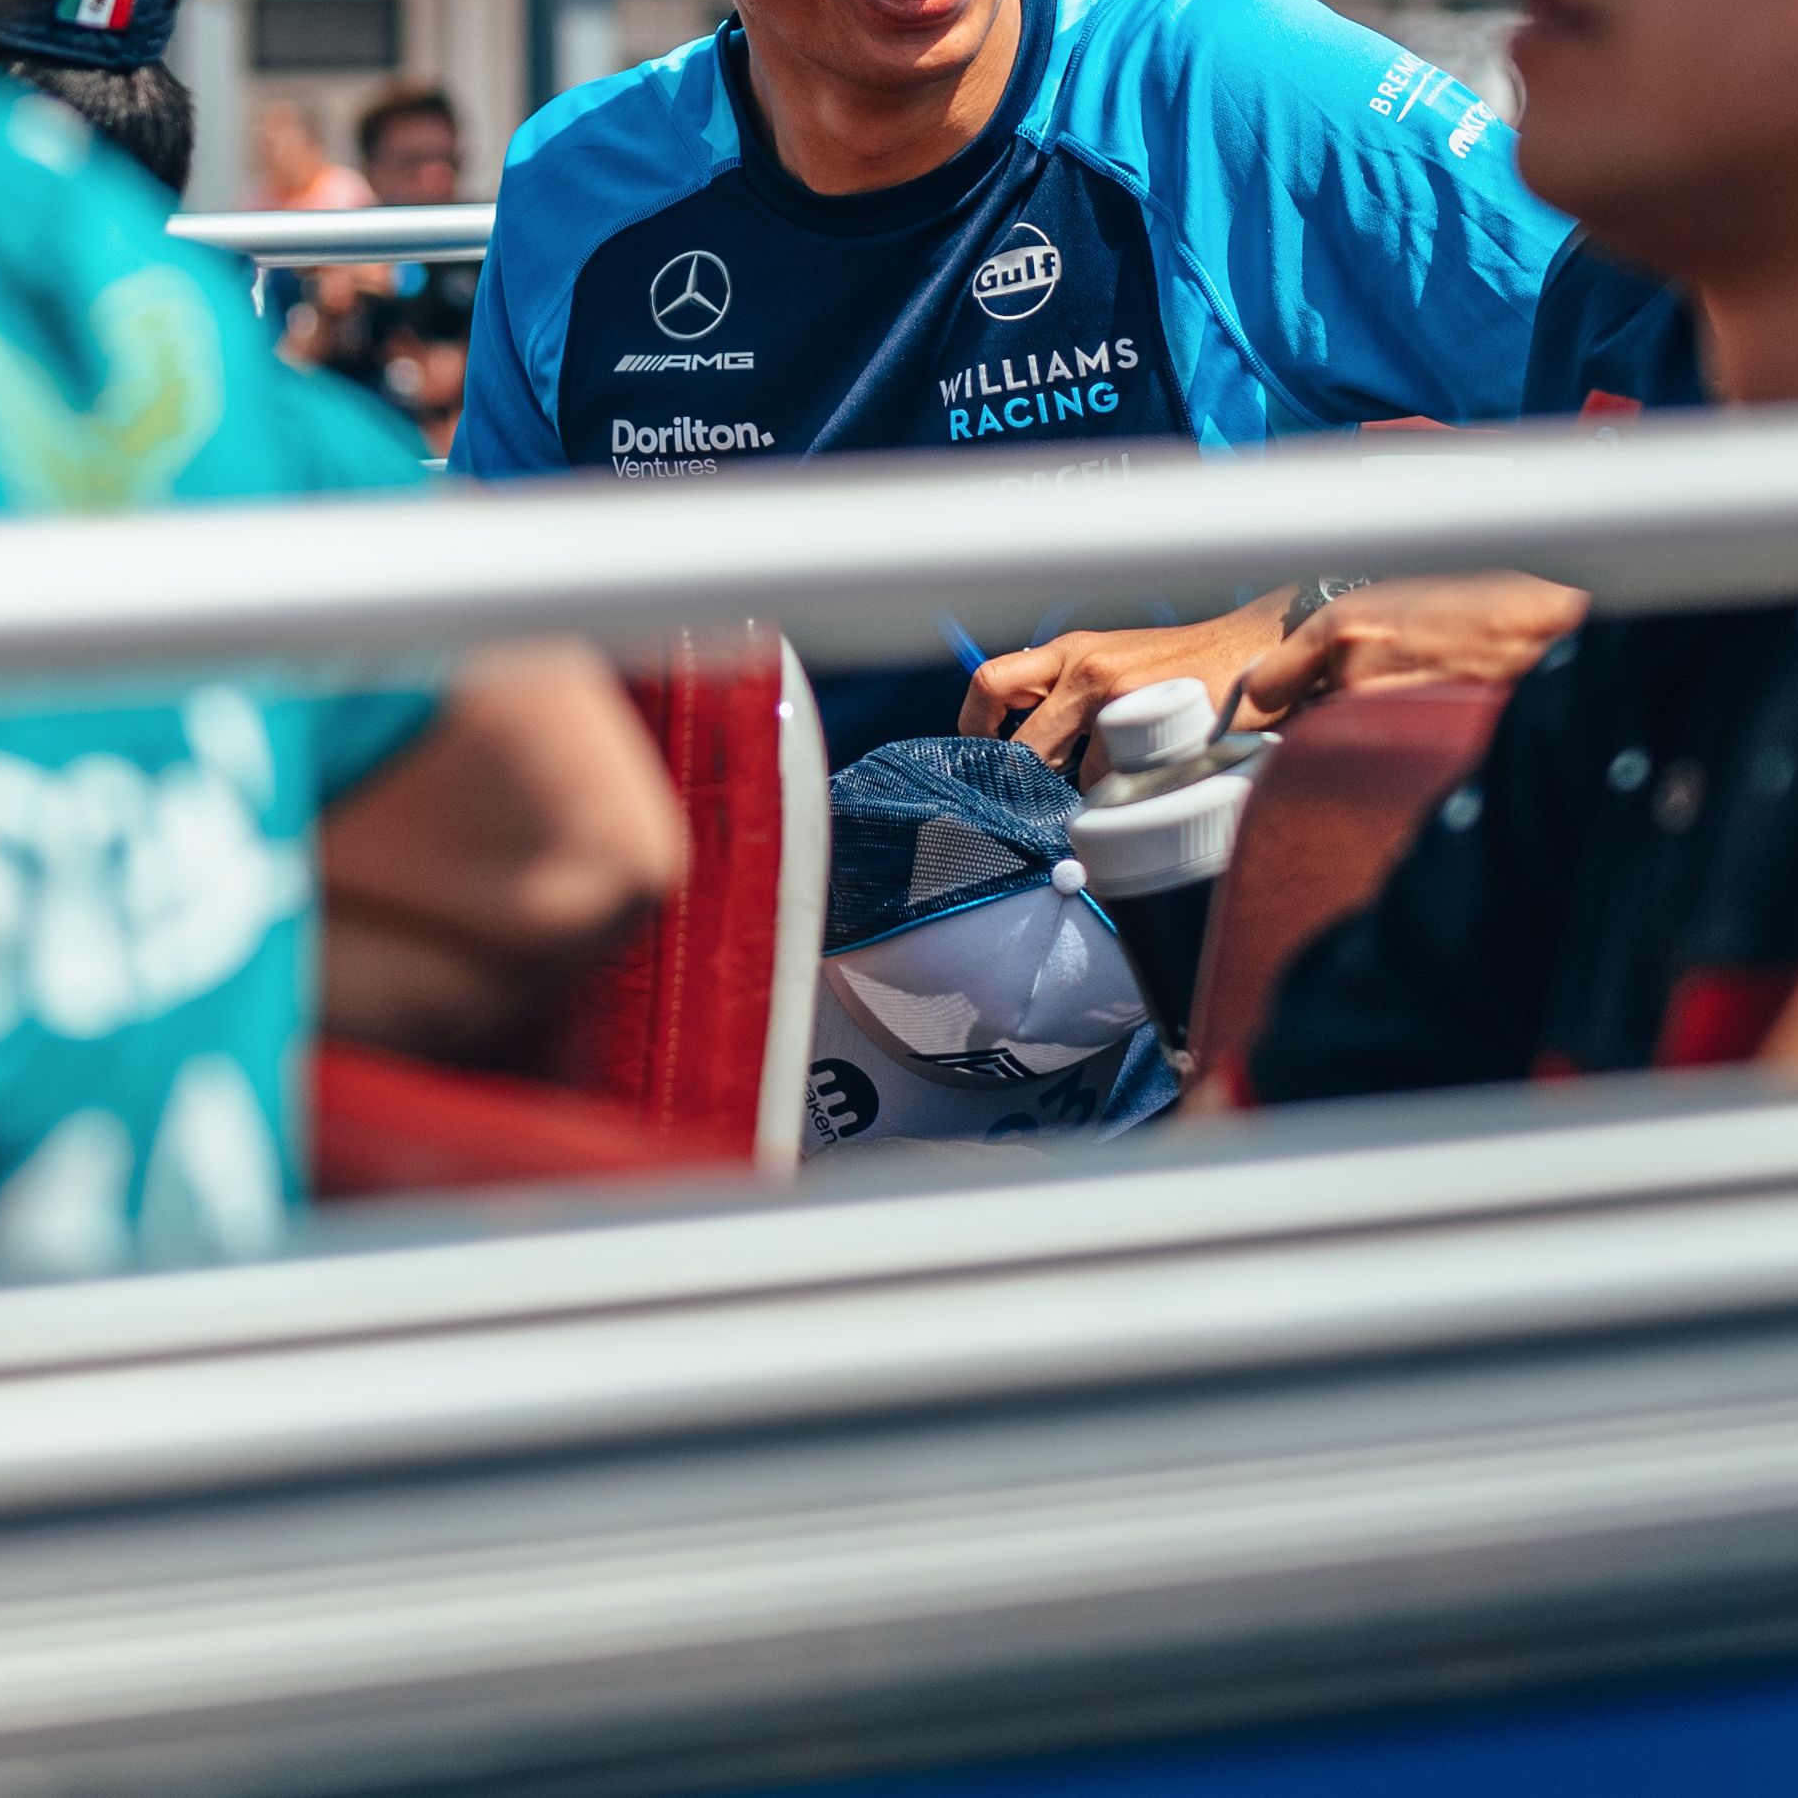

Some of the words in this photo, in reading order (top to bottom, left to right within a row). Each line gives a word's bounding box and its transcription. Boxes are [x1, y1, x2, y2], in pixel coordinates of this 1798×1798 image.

[975, 252, 1057, 293] Gulf
[657, 352, 755, 372] AMG
[939, 338, 1139, 408] WILLIAMS
[949, 381, 1119, 441] RACING
[612, 455, 718, 479] Ventures
